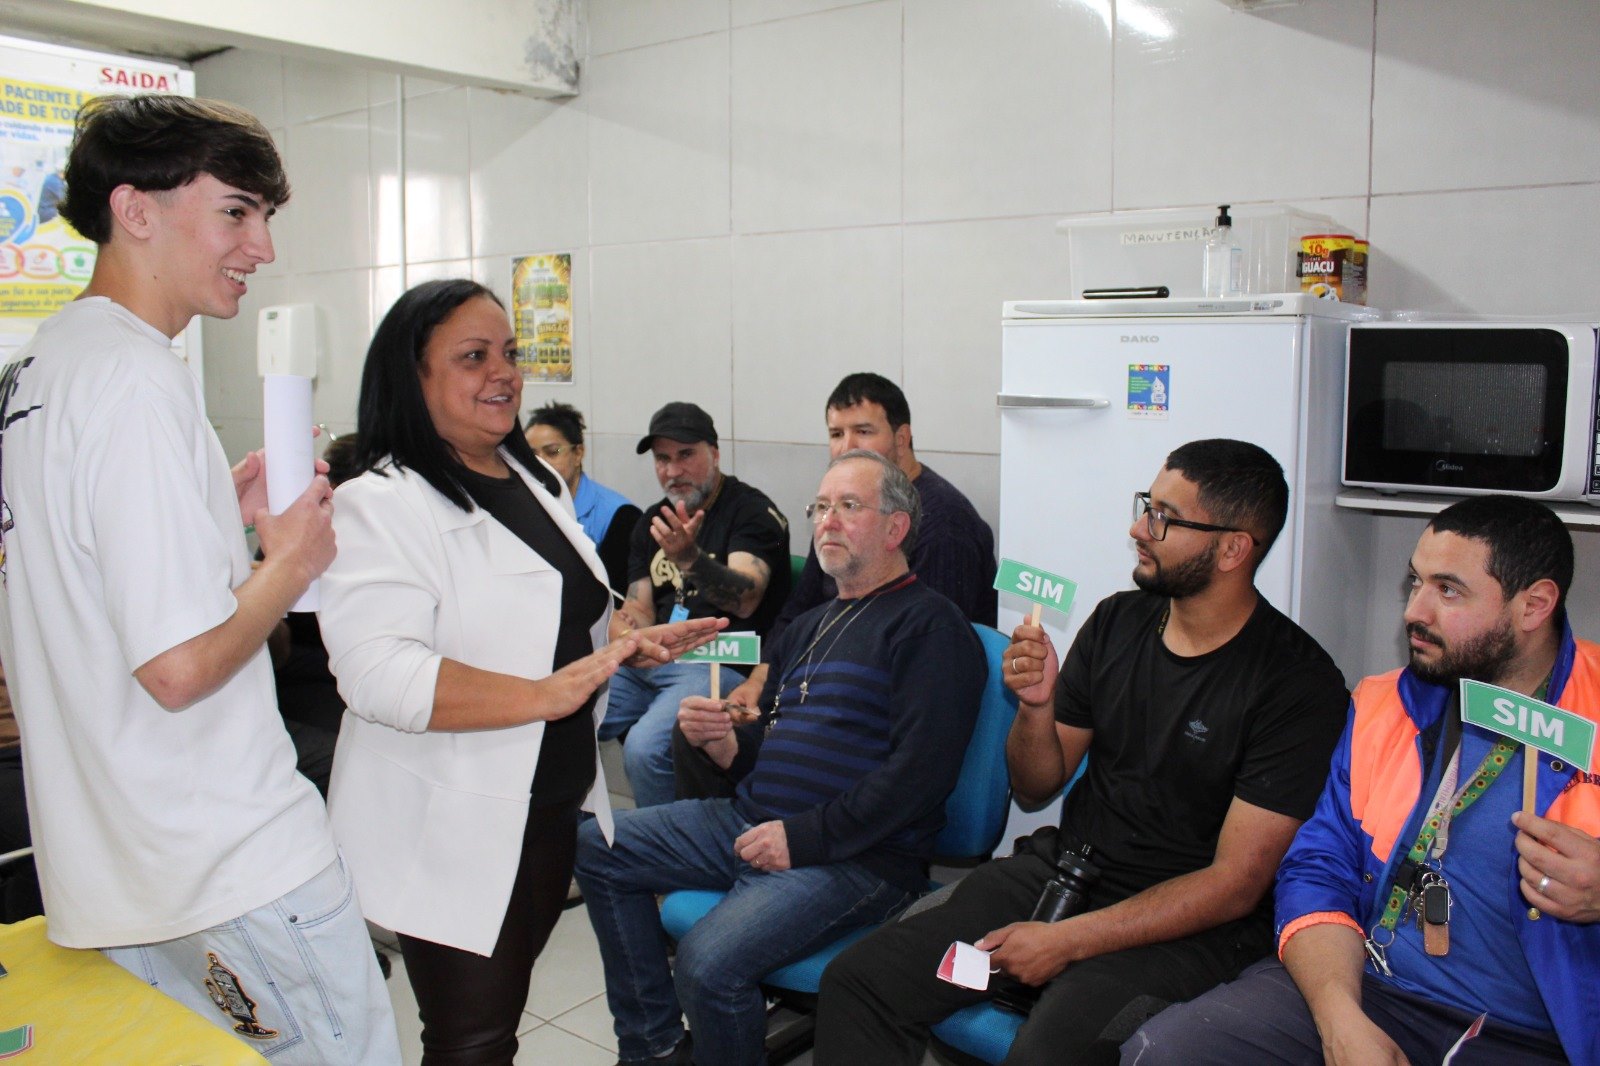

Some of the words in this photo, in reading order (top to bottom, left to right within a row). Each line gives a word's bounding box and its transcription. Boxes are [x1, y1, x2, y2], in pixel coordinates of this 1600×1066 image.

[5, 85, 71, 105] PACIENTE
[29, 103, 47, 118] DE
[1309, 244, 1329, 256] 10g
[1120, 335, 1160, 343] DAKO
[1016, 571, 1064, 604] SIM
[692, 640, 739, 657] SIM
[1492, 697, 1564, 747] SIM
